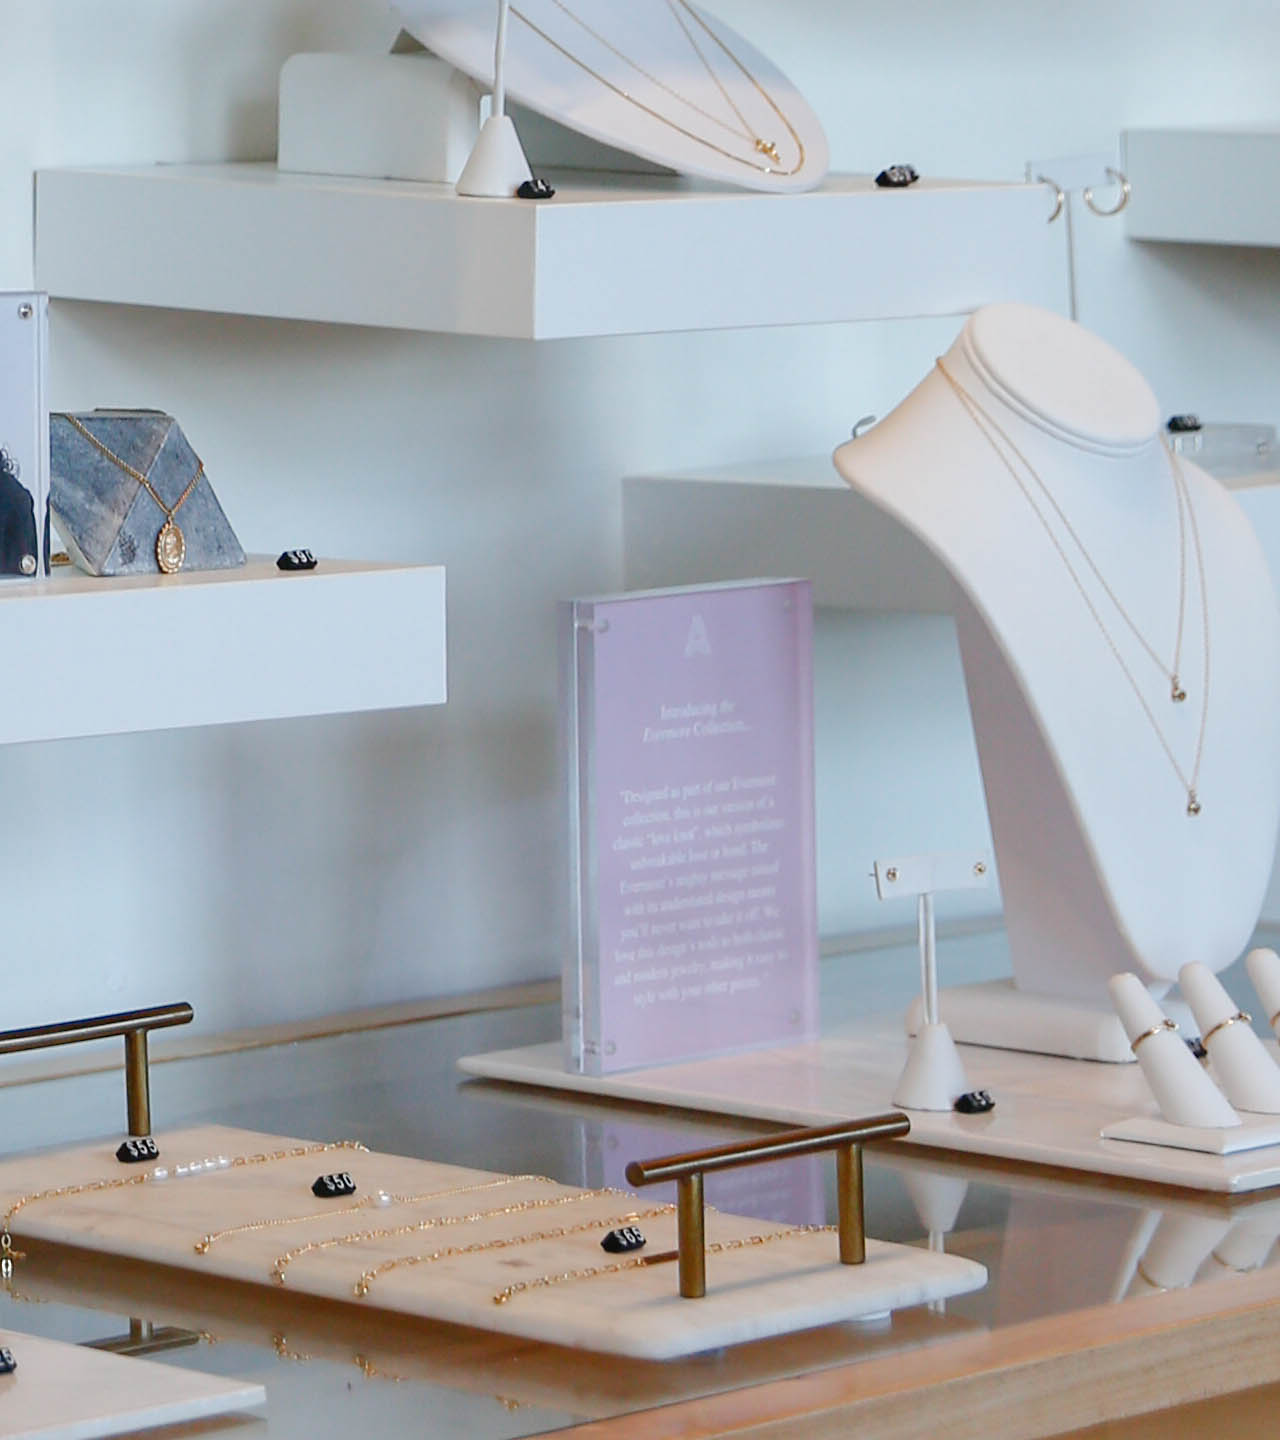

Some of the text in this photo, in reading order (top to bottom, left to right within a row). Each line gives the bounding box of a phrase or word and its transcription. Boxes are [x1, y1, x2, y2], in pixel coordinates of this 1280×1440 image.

[128, 1138, 157, 1157] $55
[324, 1172, 354, 1191] $50
[615, 1226, 644, 1246] $65
